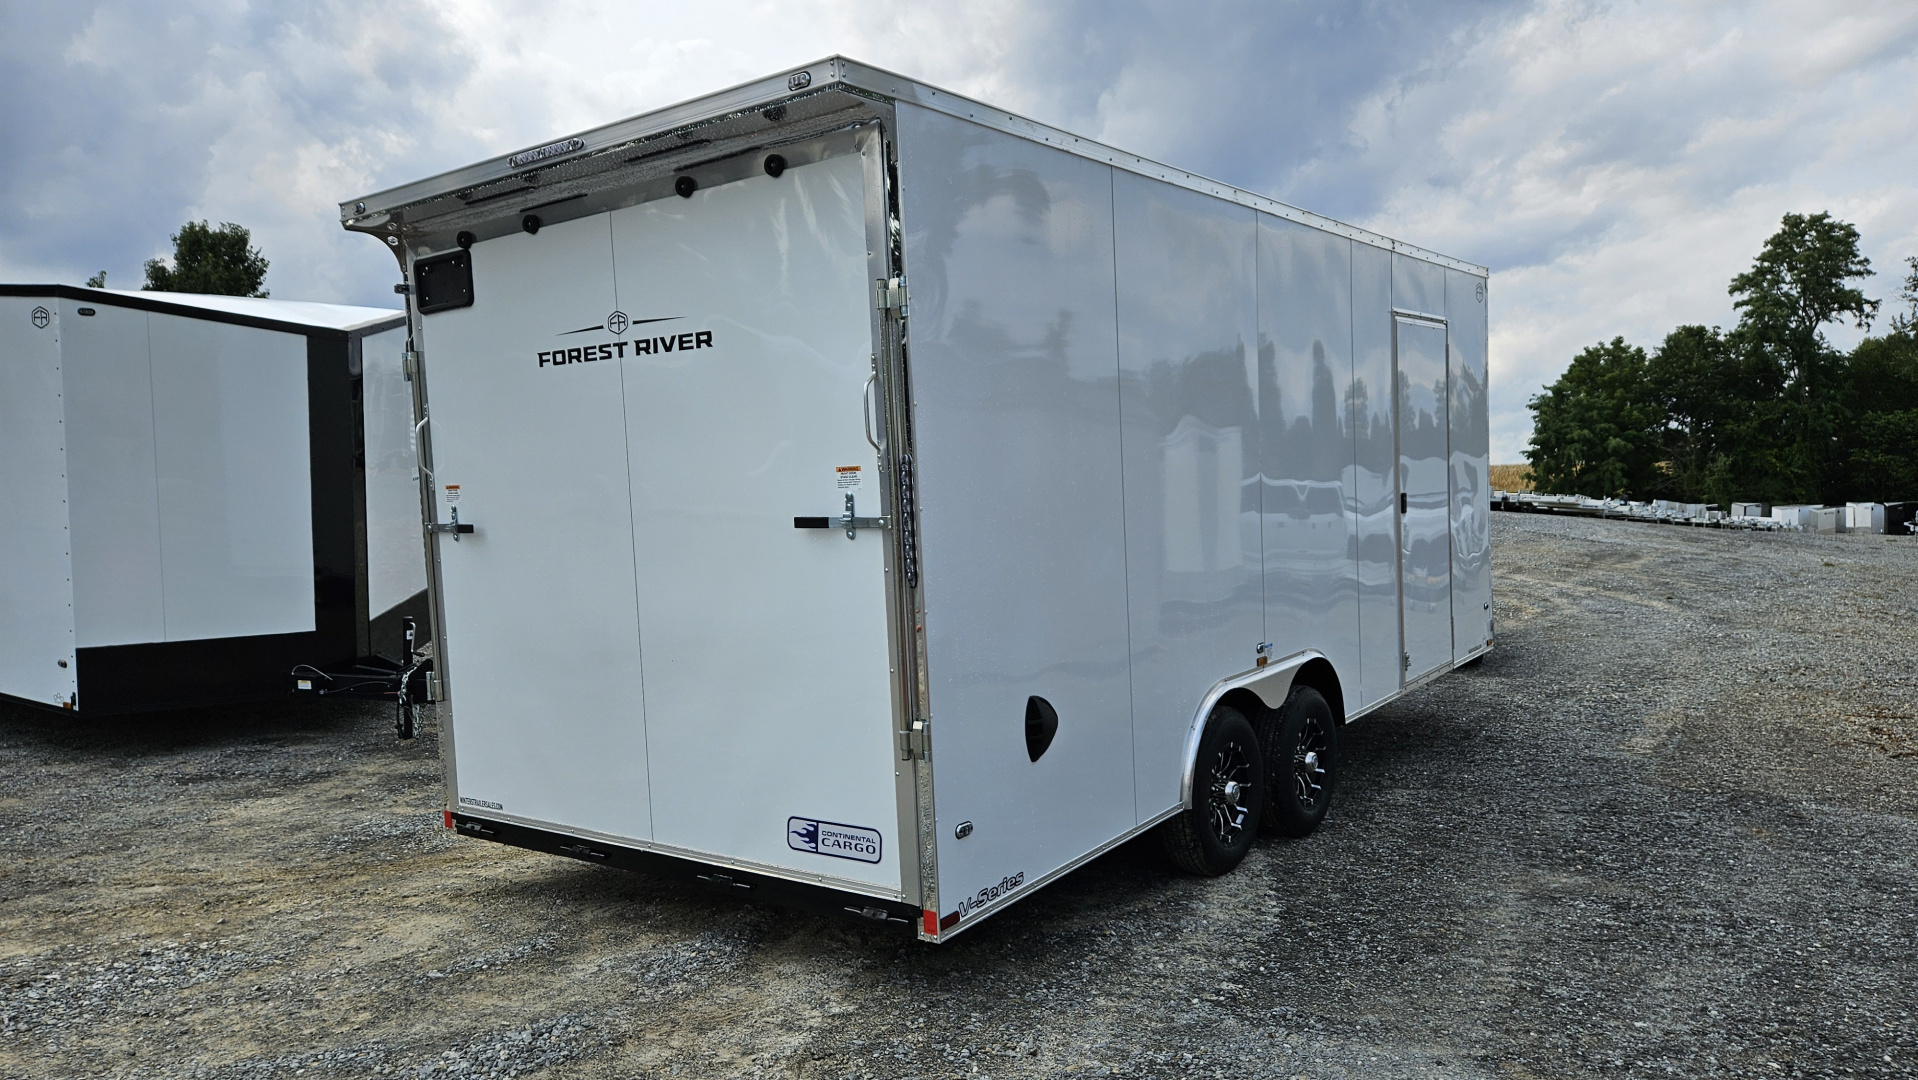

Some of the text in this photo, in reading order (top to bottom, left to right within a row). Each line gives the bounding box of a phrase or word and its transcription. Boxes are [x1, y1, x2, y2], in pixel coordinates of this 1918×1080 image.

[537, 330, 713, 368] FOREST RIVER
[821, 830, 876, 844] CONTINENTAL
[821, 837, 876, 855] CARGO
[958, 871, 1024, 918] V-Series
